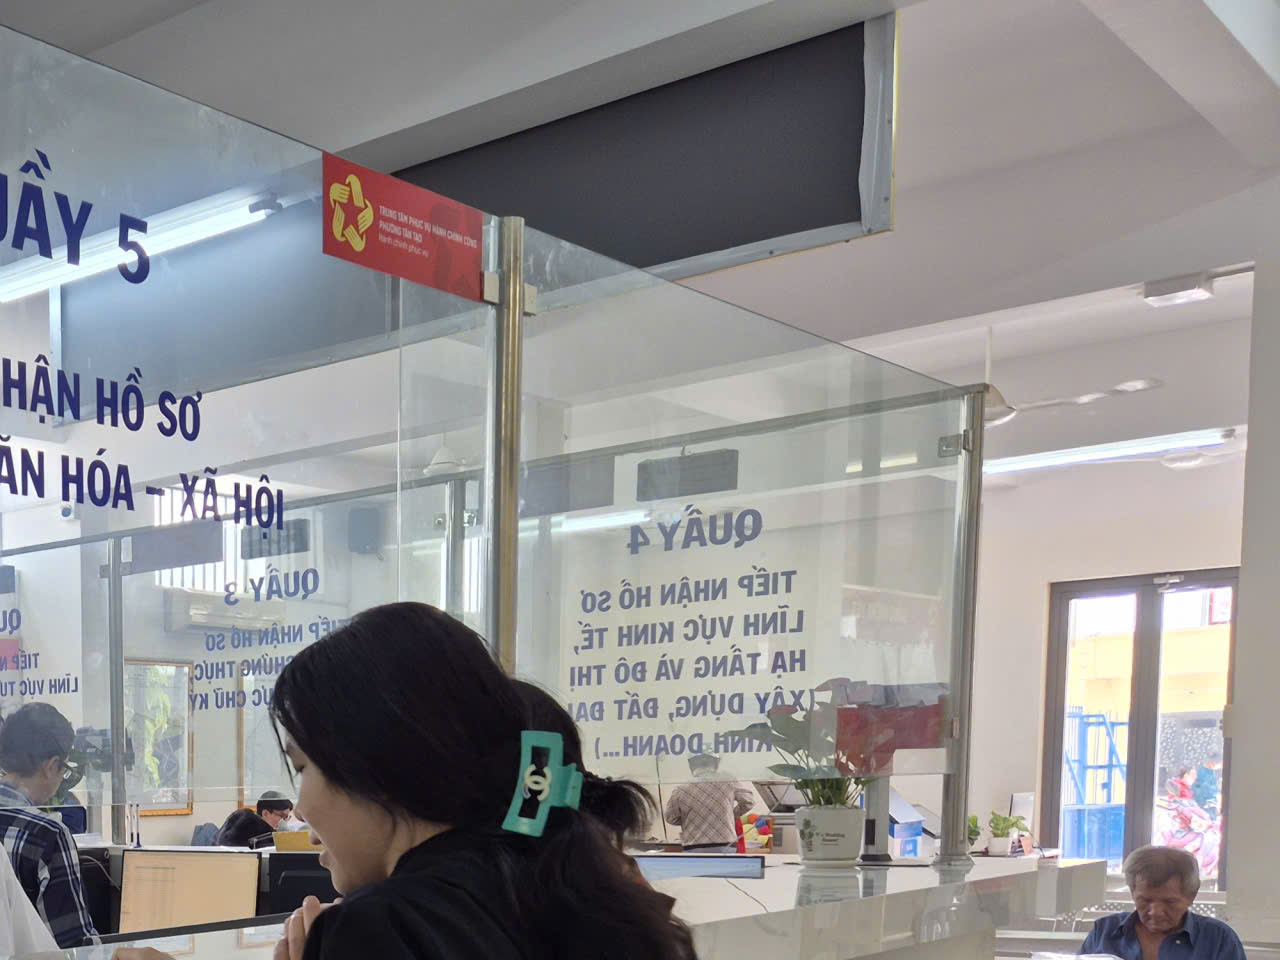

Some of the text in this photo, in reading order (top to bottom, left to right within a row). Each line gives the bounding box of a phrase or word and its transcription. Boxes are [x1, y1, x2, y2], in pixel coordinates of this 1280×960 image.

[118, 214, 150, 285] 5
[96, 367, 147, 432] HỒ
[157, 391, 202, 442] SƠ
[61, 446, 135, 511] HÓA
[180, 466, 221, 522] XÃ
[232, 472, 284, 531] HỘI
